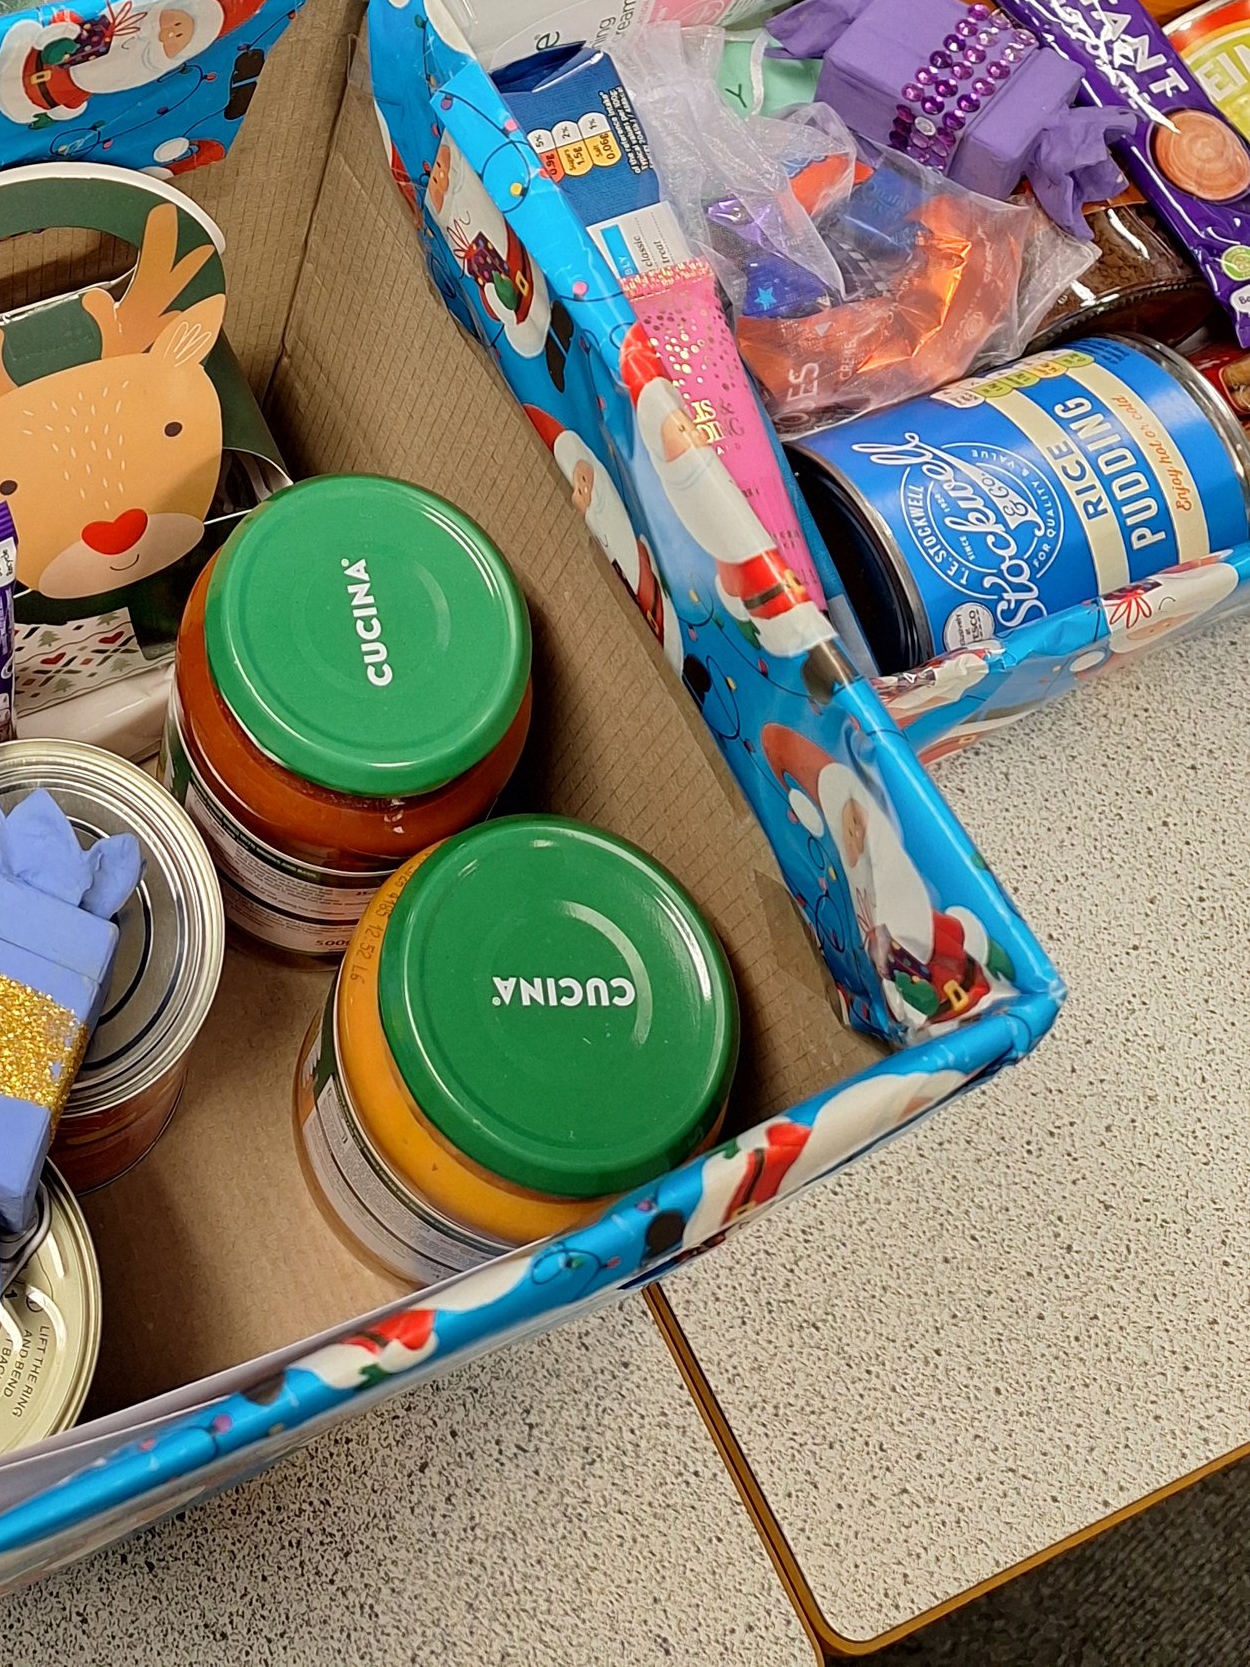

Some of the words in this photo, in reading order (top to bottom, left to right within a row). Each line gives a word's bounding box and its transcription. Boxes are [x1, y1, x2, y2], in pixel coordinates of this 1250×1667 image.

[534, 134, 545, 148] 5%
[561, 125, 571, 139] 2%
[600, 132, 616, 160] 0.06g
[573, 146, 585, 166] 1.5g
[634, 235, 653, 267] classic
[654, 241, 671, 264] treat
[1112, 395, 1143, 422] cold
[970, 448, 1016, 468] VALUE
[1149, 441, 1174, 467] hot
[1046, 440, 1109, 522] RICE
[1053, 396, 1167, 552] PUDDING
[1165, 465, 1192, 512] Enjoy
[906, 484, 947, 564] STOCKWELL
[1031, 480, 1057, 539] QUALITY
[852, 432, 1049, 628] Stockwell
[958, 534, 977, 561] SINCE
[1032, 543, 1052, 568] FOR
[341, 556, 395, 689] CUCINA
[493, 975, 637, 1008] CUCINA
[34, 1325, 50, 1354] LIFT
[3, 1358, 27, 1398] BEND
[27, 1354, 44, 1383] THE
[12, 1384, 35, 1418] RING
